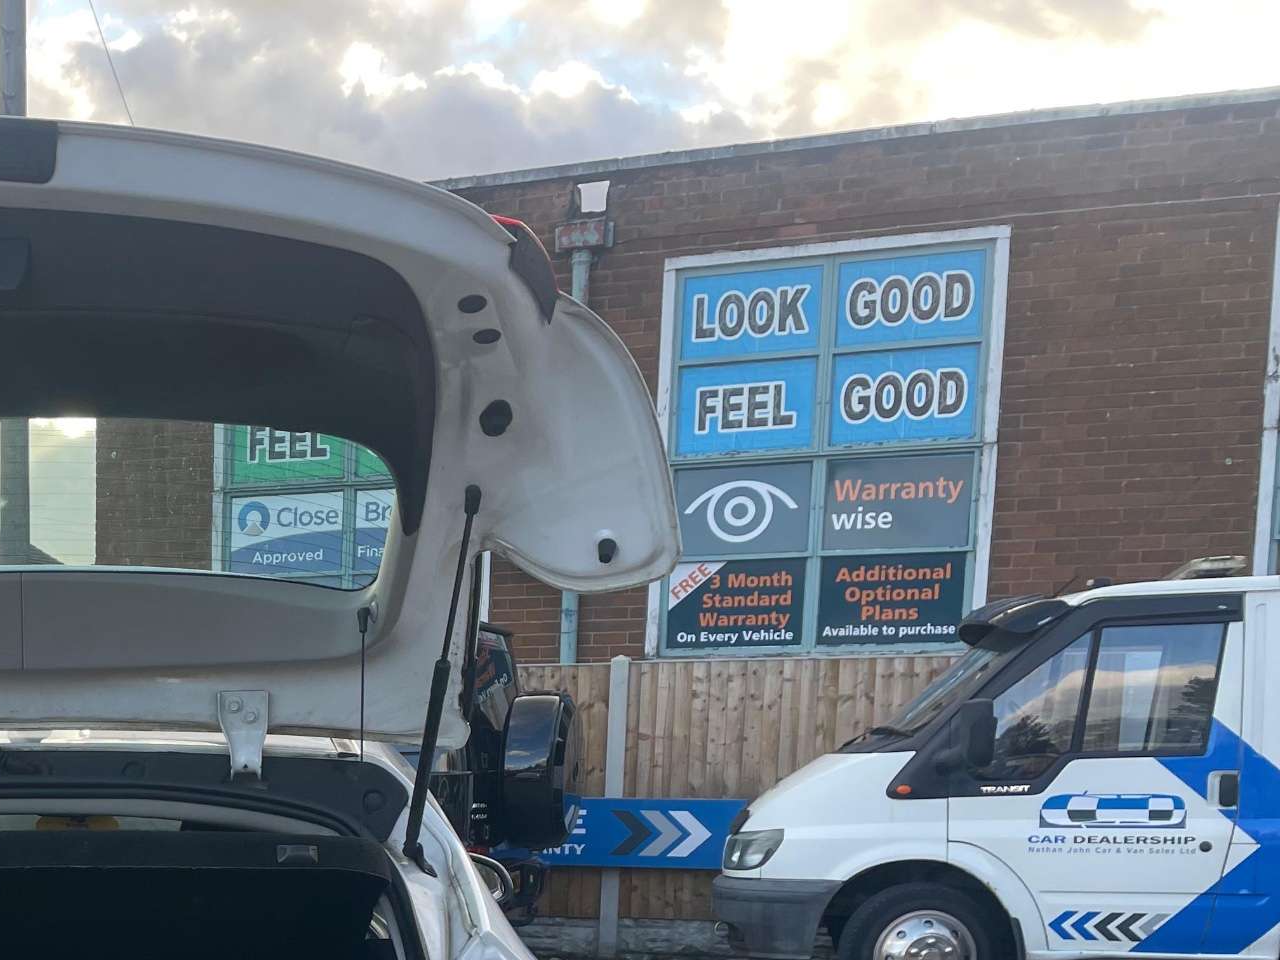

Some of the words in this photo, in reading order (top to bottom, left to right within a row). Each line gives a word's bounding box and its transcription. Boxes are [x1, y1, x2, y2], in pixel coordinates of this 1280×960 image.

[847, 270, 974, 327] GOOD
[693, 285, 811, 341] LOOK
[841, 369, 968, 423] GOOD
[695, 381, 796, 434] FEEL
[247, 426, 330, 463] FEEL
[834, 476, 964, 504] Warranty
[277, 507, 339, 528] Close
[366, 501, 391, 521] Br
[831, 506, 893, 530] wise
[252, 548, 323, 565] Approved
[671, 563, 712, 600] FREE
[710, 574, 721, 589] 3
[728, 571, 793, 588] Month
[835, 562, 952, 582] Additional
[702, 590, 792, 608] Standard
[844, 583, 940, 605] Optional
[699, 610, 790, 628] Warranty
[861, 605, 918, 620] Plans
[677, 632, 696, 642] On
[700, 631, 738, 643] Every
[743, 629, 793, 641] Vehicle
[822, 624, 878, 637] Available
[882, 625, 895, 635] to
[899, 623, 956, 637] purchase
[980, 784, 1031, 794] TRANSIT
[1028, 834, 1066, 844] CAR
[1073, 835, 1196, 845] DEALERSHIP
